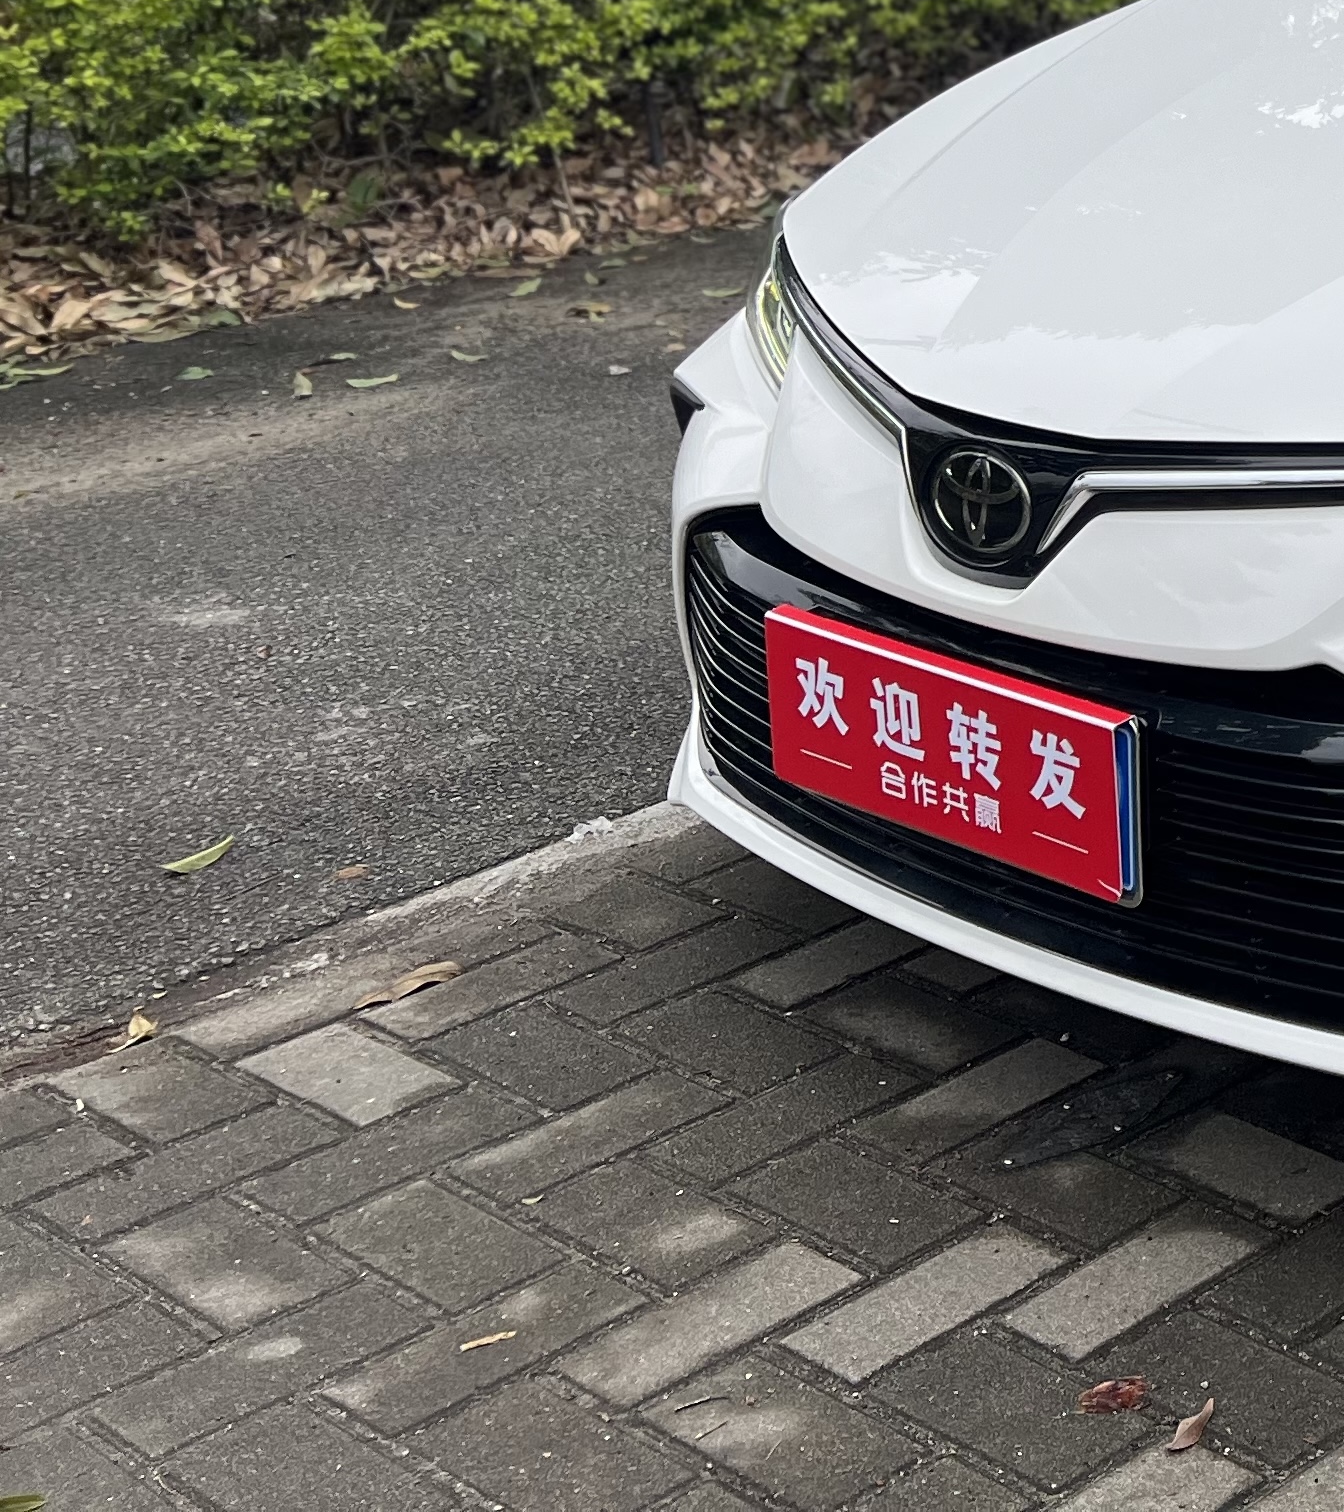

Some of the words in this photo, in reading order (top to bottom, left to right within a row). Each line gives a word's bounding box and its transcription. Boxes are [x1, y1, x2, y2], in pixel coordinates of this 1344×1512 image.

[795, 657, 1087, 819] 欢迎转发
[880, 761, 1002, 834] 合作共赢
